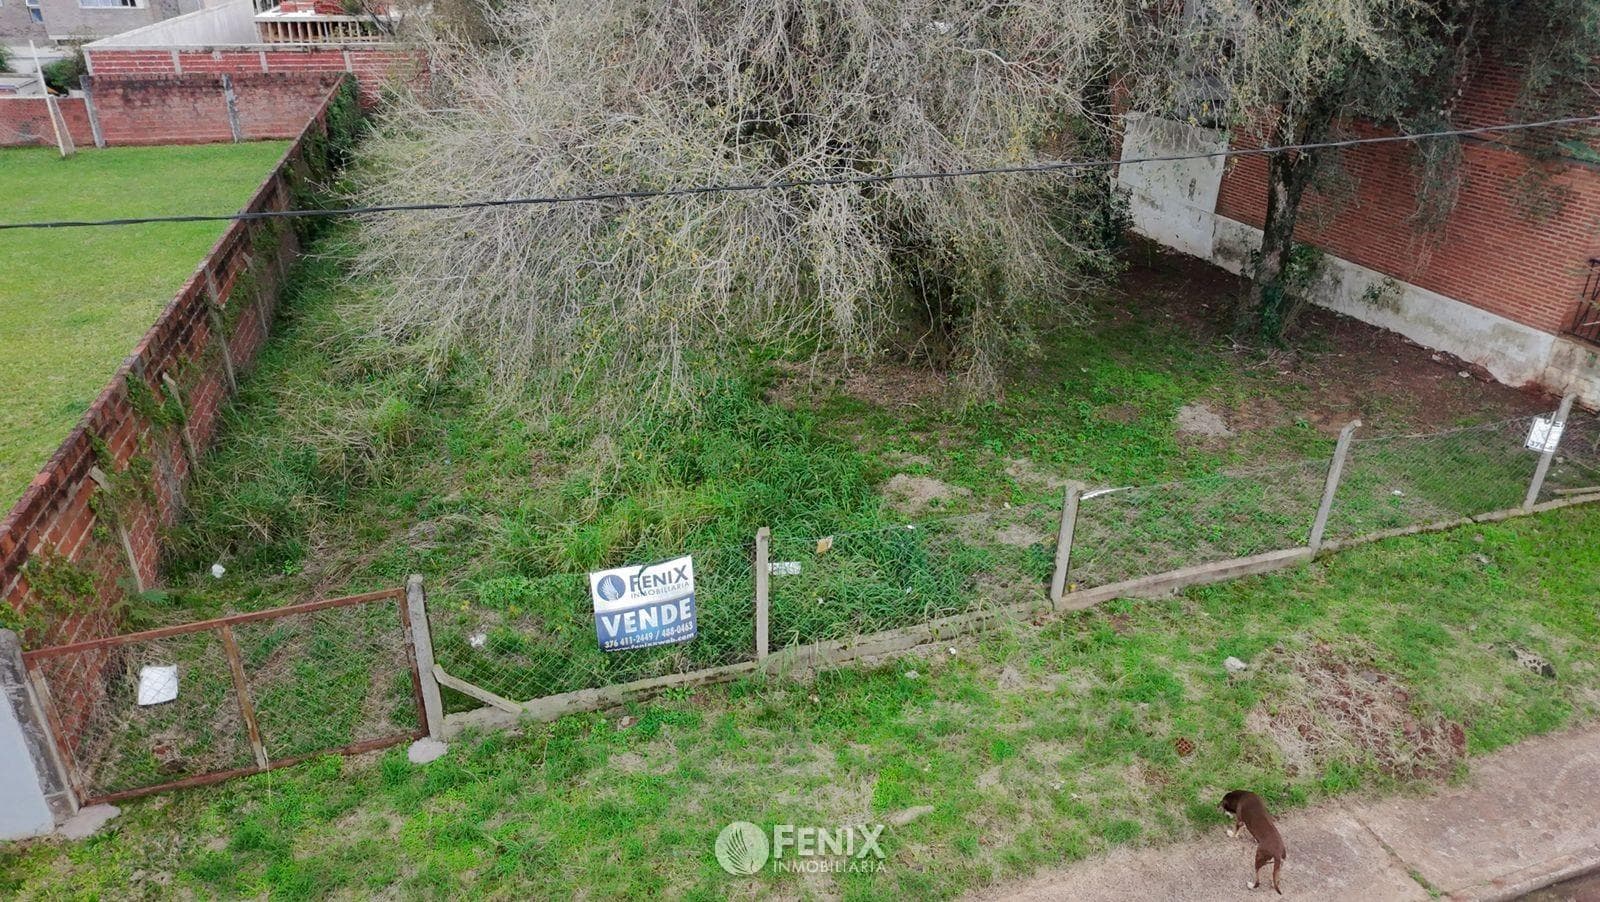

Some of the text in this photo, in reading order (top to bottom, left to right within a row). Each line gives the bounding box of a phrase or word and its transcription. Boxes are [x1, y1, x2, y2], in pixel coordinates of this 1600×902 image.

[629, 565, 688, 592] FENIX
[630, 581, 690, 599] INMOBILIARIA
[601, 597, 692, 638] VENDE
[604, 640, 618, 648] 376
[620, 632, 653, 646] 411-2449
